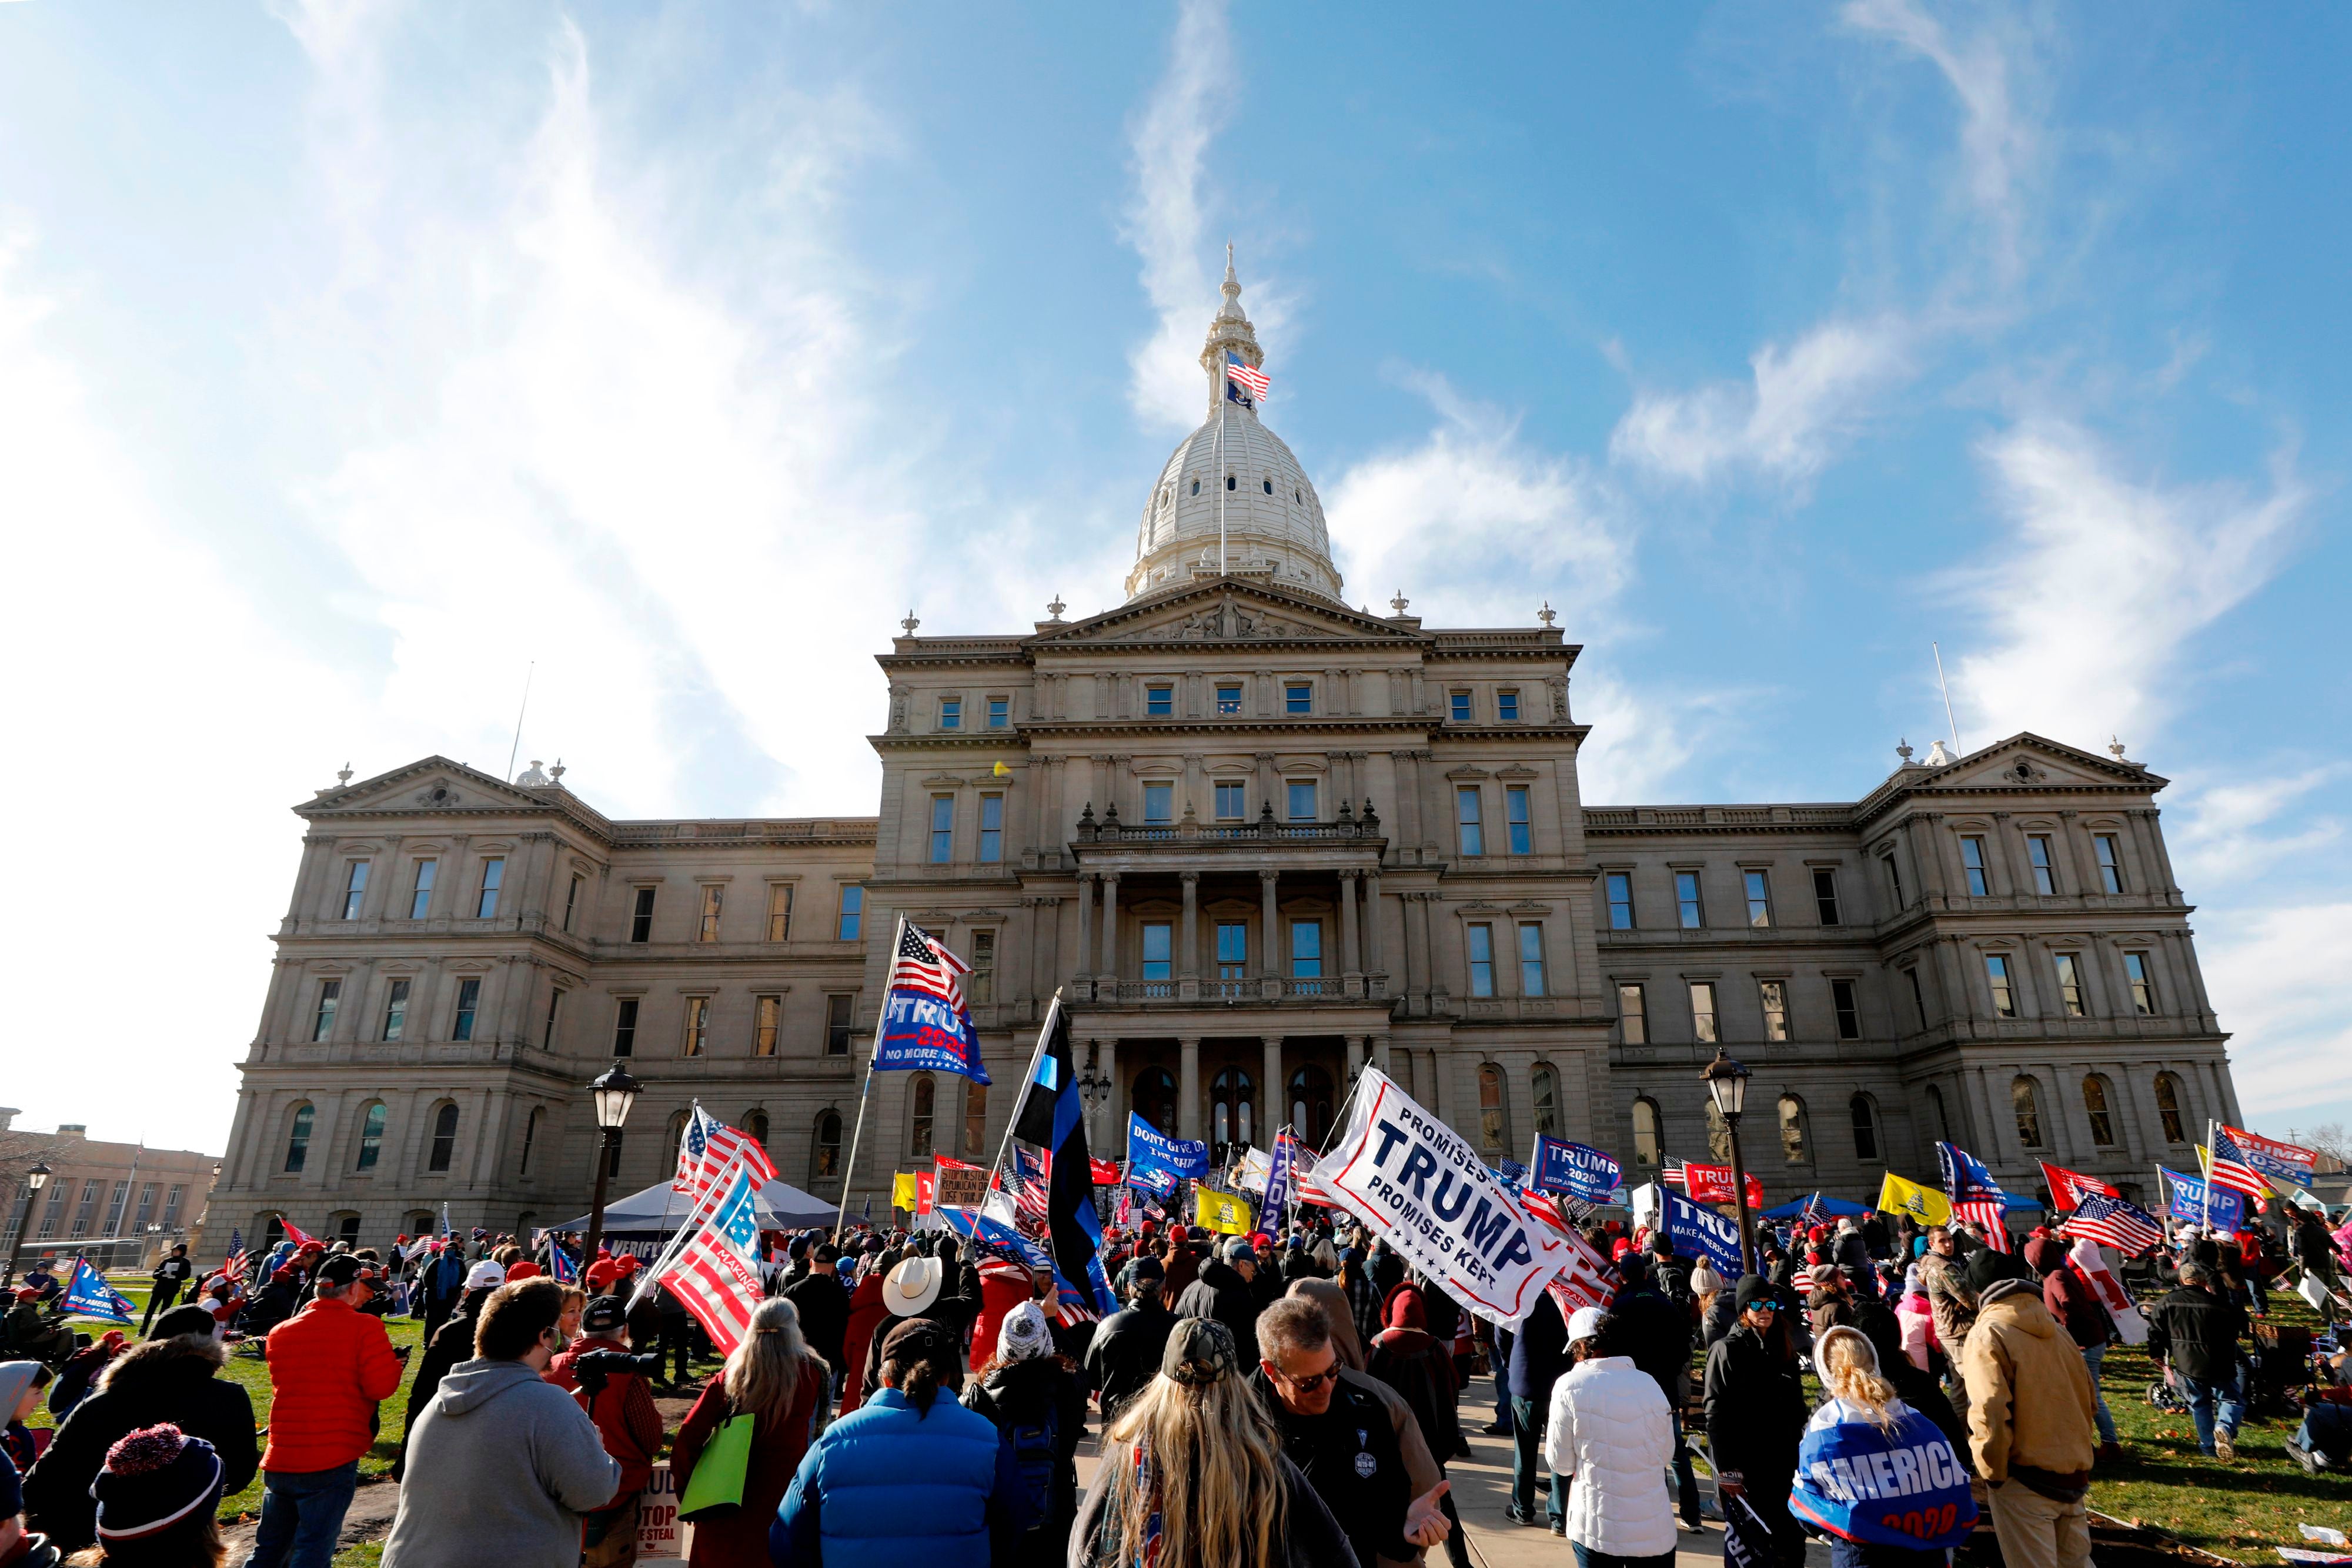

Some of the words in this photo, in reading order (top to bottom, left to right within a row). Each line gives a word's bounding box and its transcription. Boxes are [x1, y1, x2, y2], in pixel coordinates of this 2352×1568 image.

[895, 997, 967, 1043] TRU
[885, 1049, 901, 1059] NO
[904, 1048, 938, 1059] MORE
[1133, 1125, 1165, 1146] DONT
[1167, 1140, 1192, 1154] GIVE
[1149, 1146, 1171, 1162] THE
[1399, 1107, 1487, 1183] PROMISES
[1022, 1154, 1044, 1174] TRU
[1549, 1145, 1619, 1175] TRUMP
[941, 1181, 977, 1191] REPUBLICAN
[942, 1170, 960, 1181] STOP
[960, 1171, 970, 1180] THE
[970, 1171, 989, 1181] STEAL
[1563, 1179, 1592, 1192] AMERICA
[941, 1191, 957, 1203] LOSE
[960, 1192, 975, 1203] YOUR
[975, 1192, 985, 1203] JO
[1262, 1159, 1287, 1231] 202
[1373, 1118, 1532, 1272] TRUMP
[1568, 1196, 1586, 1212] TRUM
[2173, 1178, 2236, 1210] RUMP
[1367, 1175, 1454, 1253] PROMISES
[1454, 1247, 1496, 1290] KEPT
[1672, 1197, 1739, 1246] TRU
[611, 1240, 663, 1258] VERIFY
[1671, 1223, 1697, 1238] MAKE
[1698, 1231, 1729, 1259] AMERICA
[717, 1249, 759, 1293] MAKING
[1554, 1284, 1588, 1307] AGAIN
[1810, 1440, 1971, 1500] AMERICA
[641, 1505, 676, 1527] TOP
[647, 1527, 675, 1541] STEAL
[1724, 1521, 1753, 1568] TRU
